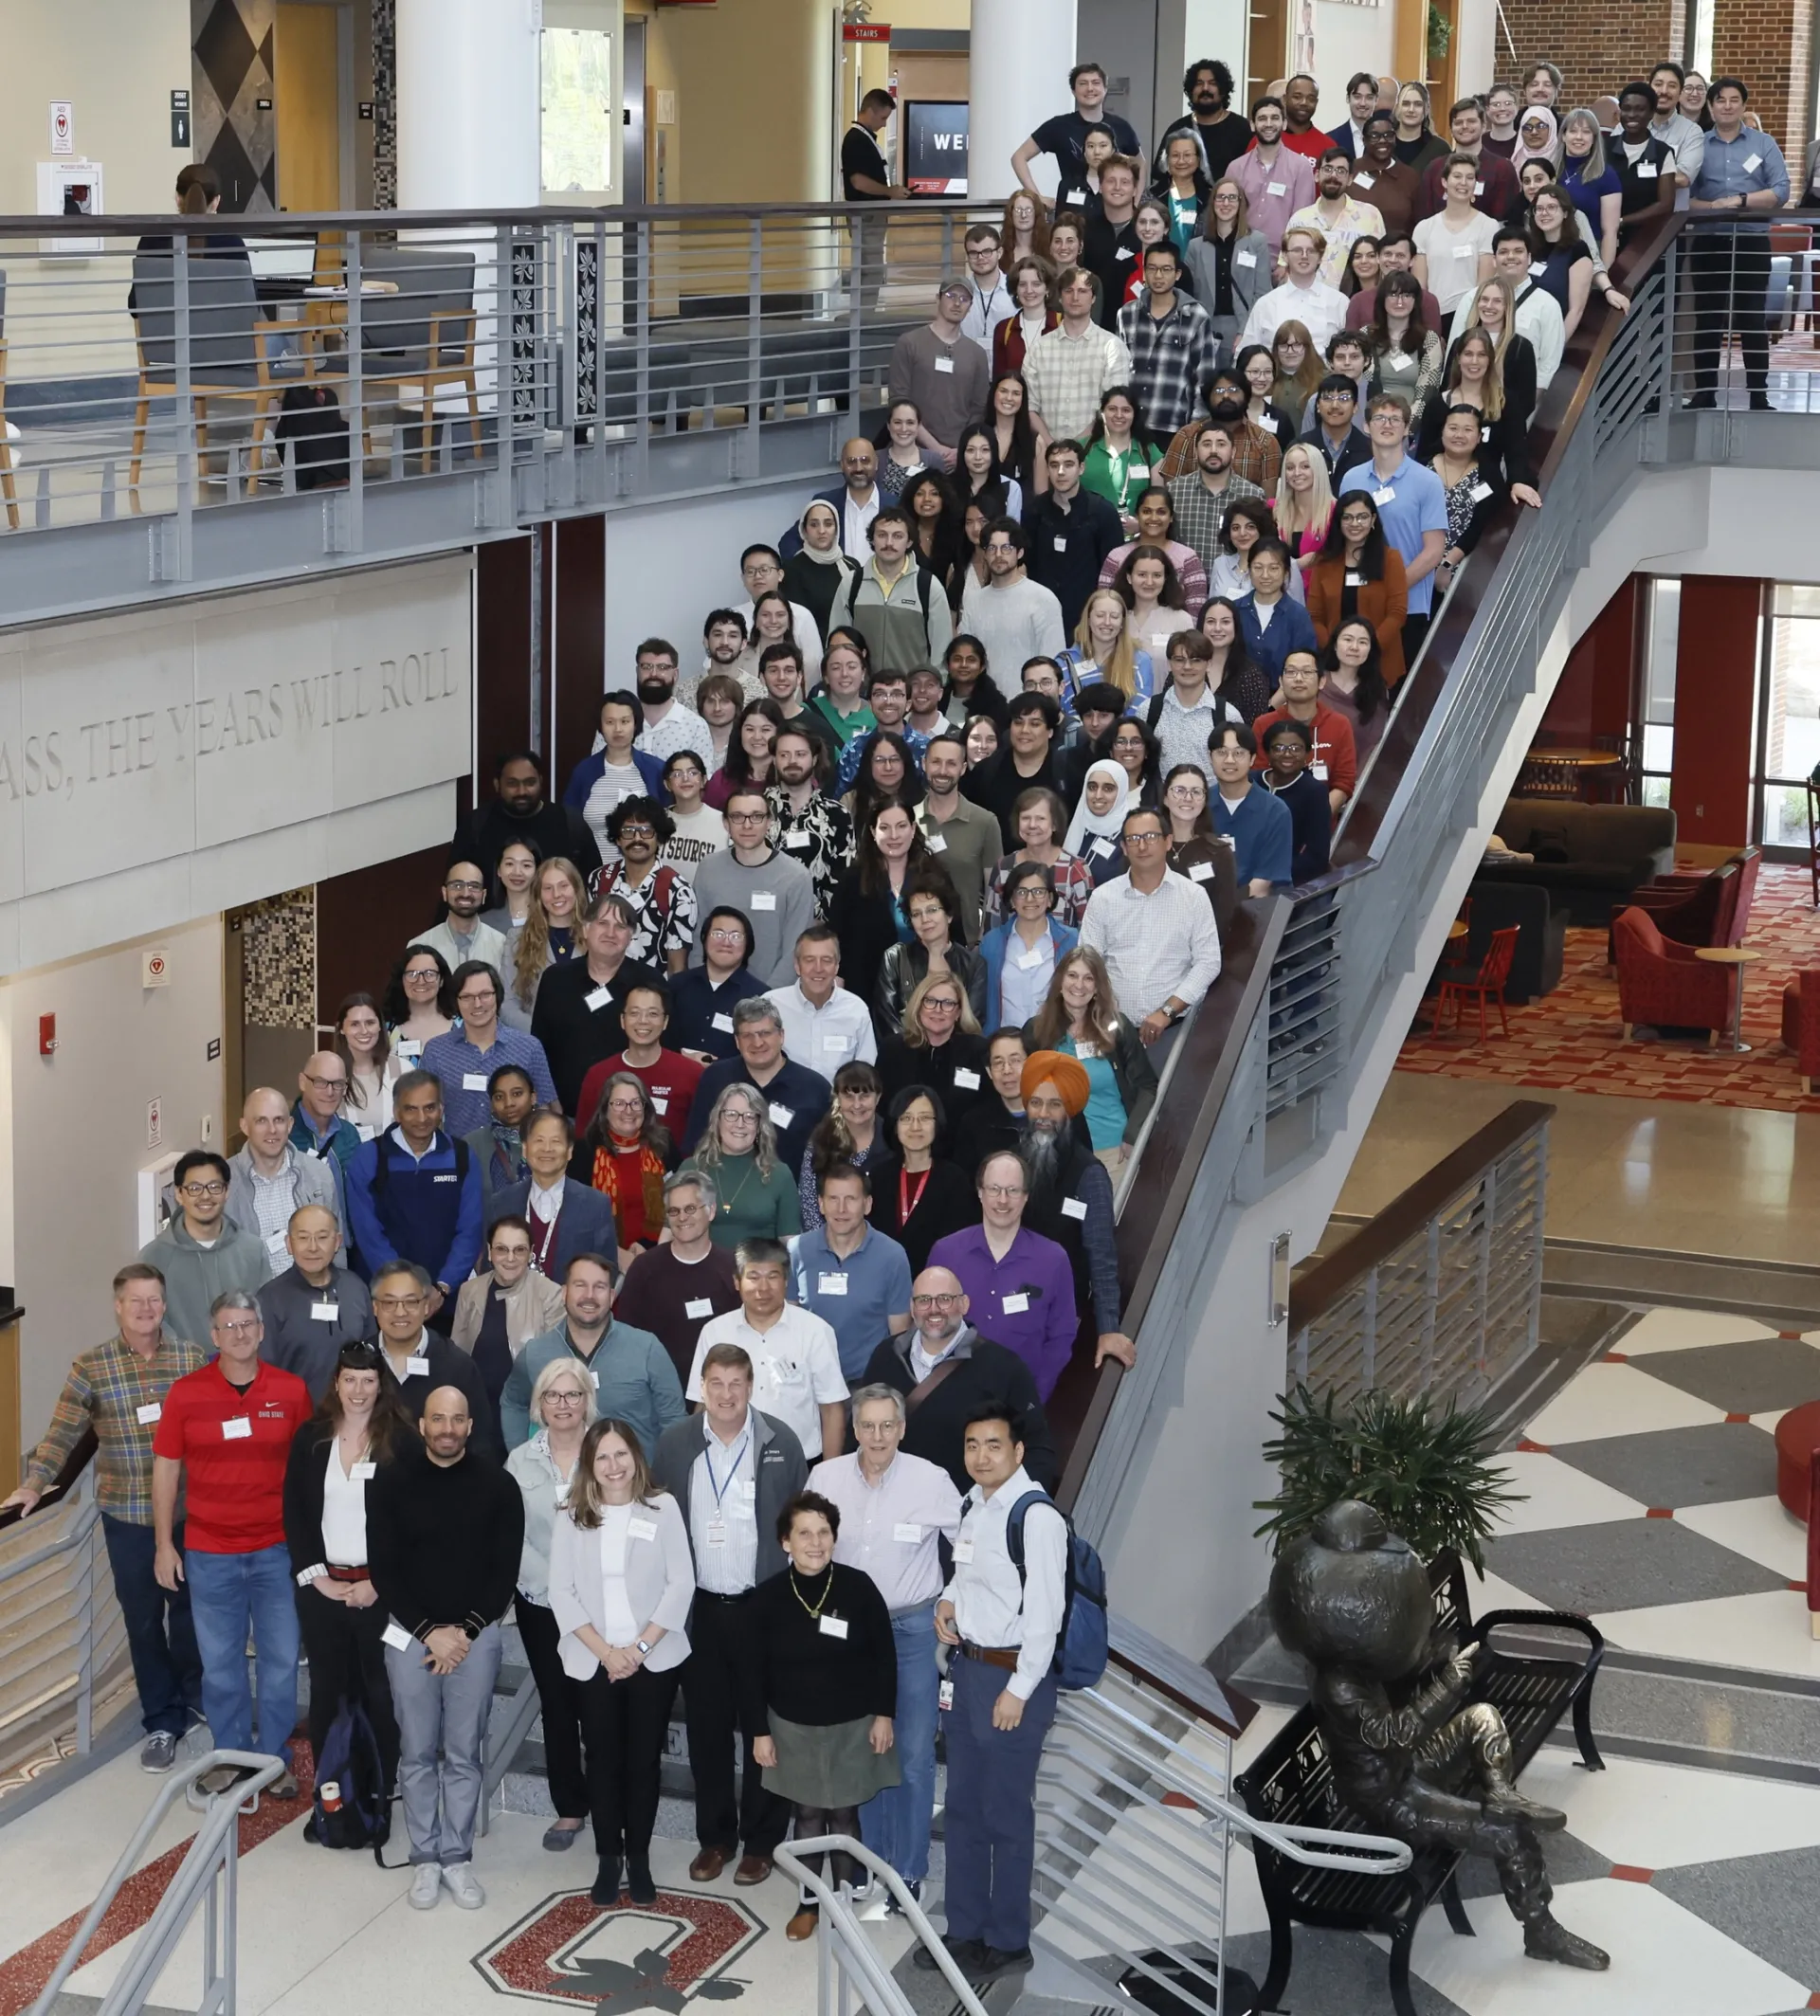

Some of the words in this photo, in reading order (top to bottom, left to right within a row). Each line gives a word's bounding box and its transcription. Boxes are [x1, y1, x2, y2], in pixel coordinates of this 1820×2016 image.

[855, 29, 879, 38] STAIRS
[81, 712, 158, 783] THE
[167, 683, 283, 761] YEARS
[290, 666, 372, 734] WILL
[380, 646, 459, 714] ROLL
